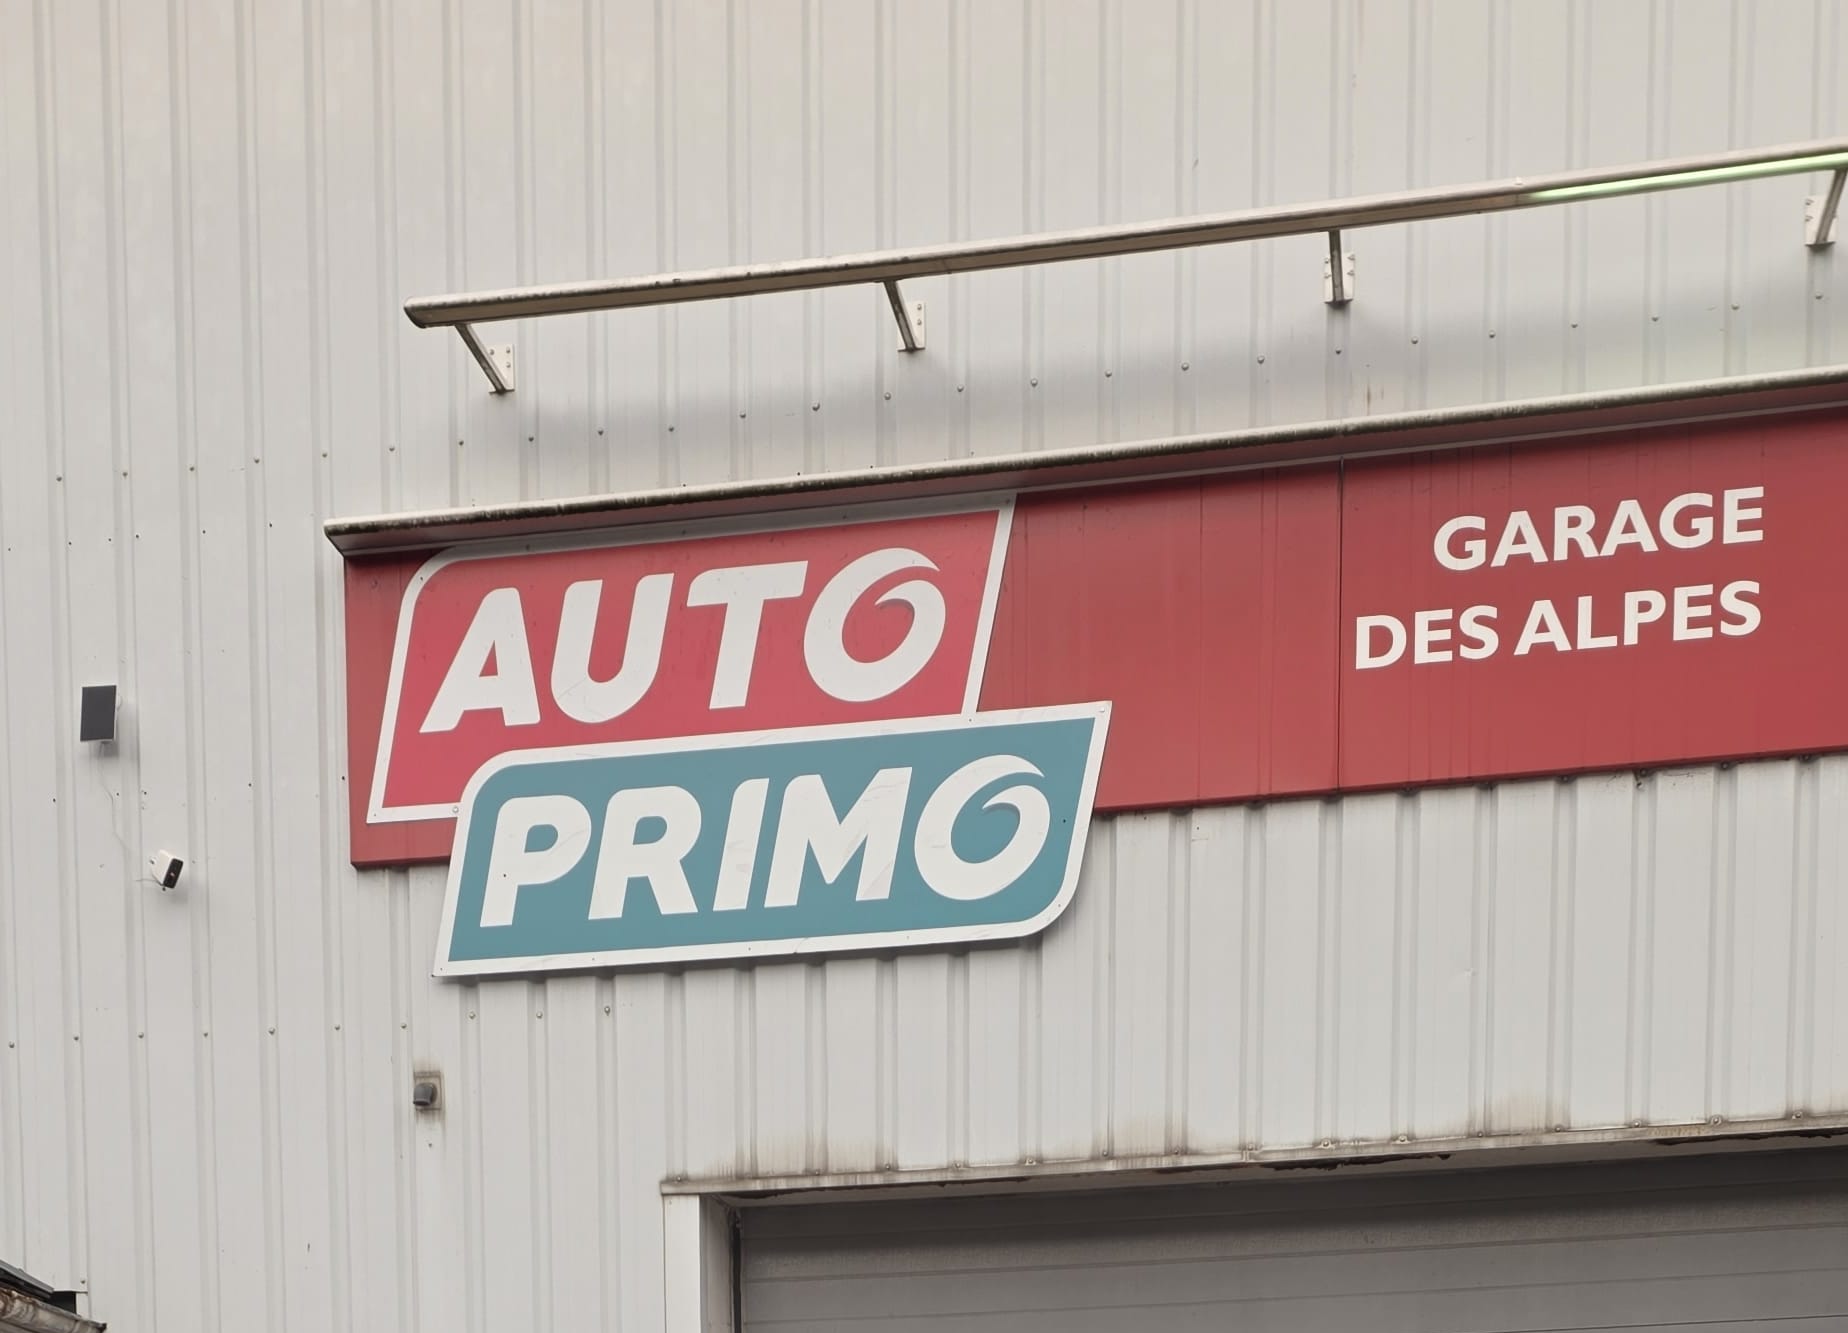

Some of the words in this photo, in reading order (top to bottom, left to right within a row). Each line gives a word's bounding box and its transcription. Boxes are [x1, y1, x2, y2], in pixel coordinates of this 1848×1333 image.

[1432, 486, 1765, 572] GARAGE
[418, 546, 947, 734] AUTO
[1355, 604, 1500, 670] DES
[1513, 580, 1762, 656] ALPES
[479, 754, 1051, 928] PRIMO
